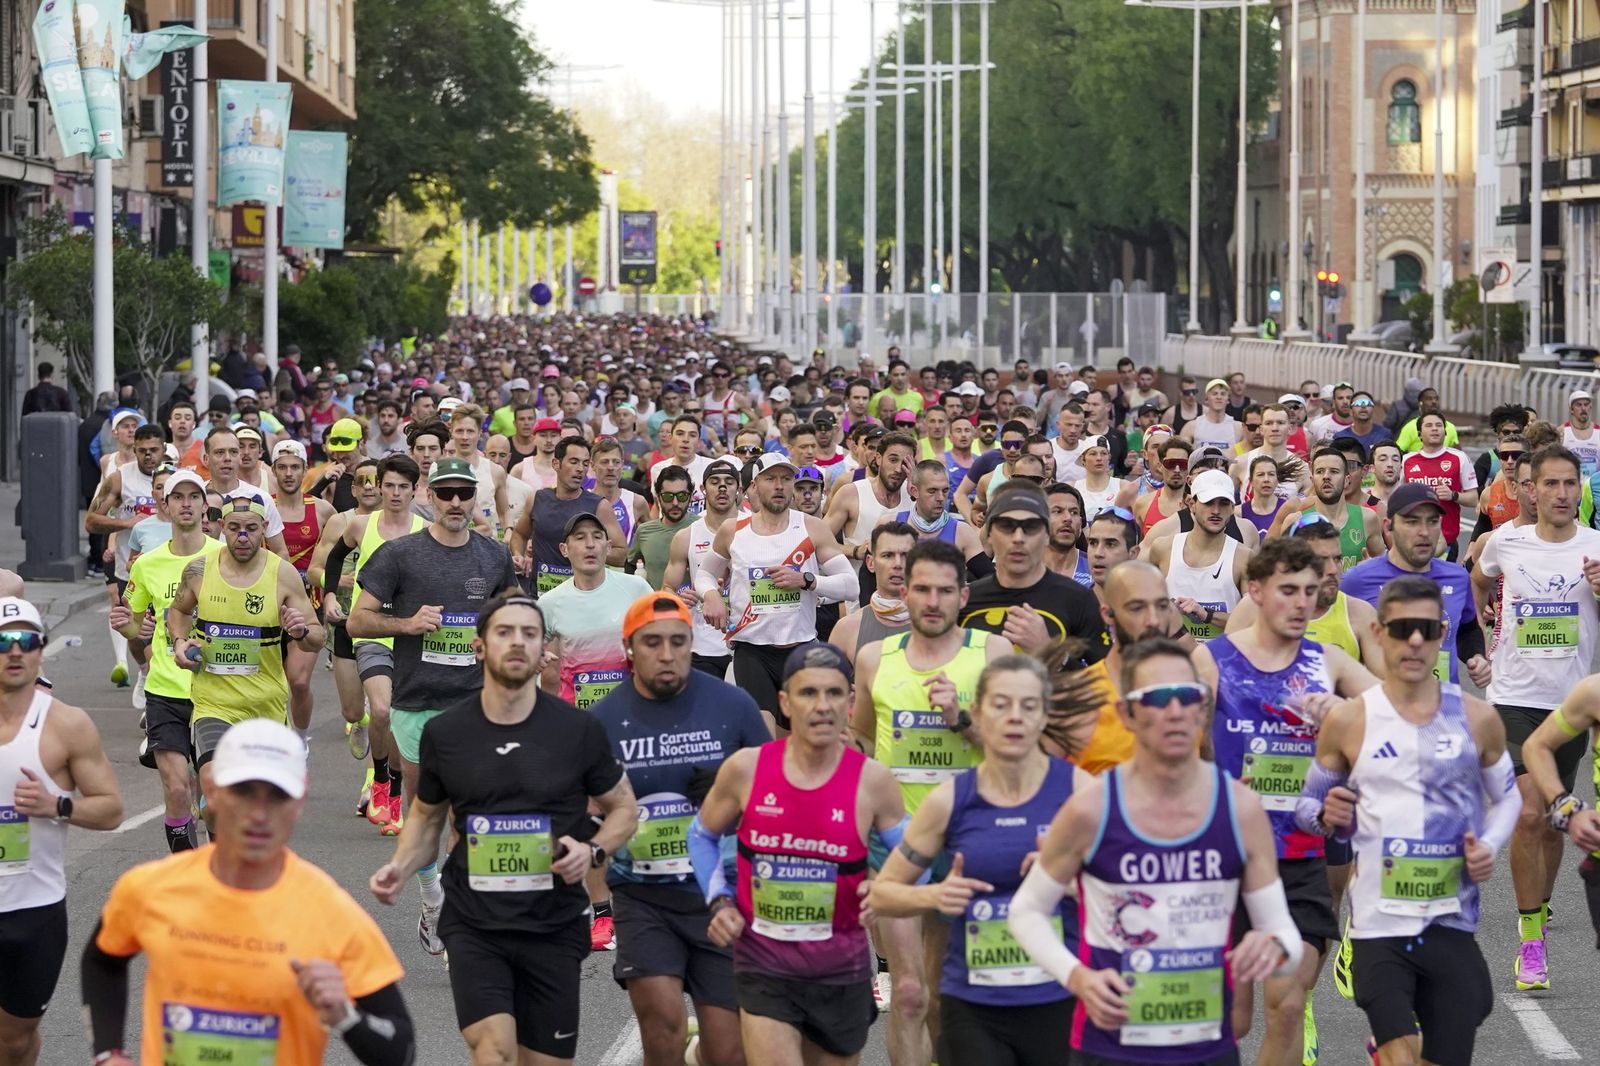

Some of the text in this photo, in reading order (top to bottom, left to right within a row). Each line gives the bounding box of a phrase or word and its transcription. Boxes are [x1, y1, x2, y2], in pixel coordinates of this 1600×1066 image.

[550, 567, 573, 575] ZURICH
[751, 592, 801, 604] TONI JAAKO
[1537, 606, 1571, 614] ZURICH
[223, 628, 255, 637] ZURICH
[1190, 625, 1210, 637] NOÉ
[1538, 622, 1556, 631] 2865
[446, 631, 463, 639] 2754
[1526, 633, 1569, 645] MIGUEL
[223, 642, 240, 651] 2503
[424, 640, 446, 652] TOM
[215, 652, 247, 663] RICAR
[592, 672, 623, 681] ZURICH
[593, 687, 610, 696] 2717
[918, 715, 946, 725] ZUR
[1226, 719, 1255, 733] US
[659, 730, 711, 745] Carrera
[920, 737, 943, 747] 3038
[619, 737, 655, 760] VII
[660, 741, 722, 757] Nocturna
[1271, 741, 1312, 753] ZURICH
[909, 751, 953, 766] MANU
[1271, 763, 1294, 774] 2289
[494, 820, 541, 831] ZURICH
[656, 826, 680, 838] 3074
[750, 829, 780, 848] Los
[496, 843, 521, 853] 2712
[650, 840, 689, 857] EBER
[1412, 843, 1457, 855] ZURICH
[490, 854, 529, 873] LEÓN
[1119, 848, 1223, 882] GOWER
[777, 866, 827, 879] ZURICH
[1395, 881, 1447, 898] MIGUEL
[779, 890, 804, 902] 3080
[758, 902, 827, 922] HERRERA
[169, 925, 287, 953] RUNNING CLUB
[971, 947, 1032, 966] RANNV
[1158, 951, 1214, 968] ZURICH
[1141, 999, 1207, 1022] GOWER
[198, 1013, 266, 1035] ZURICH
